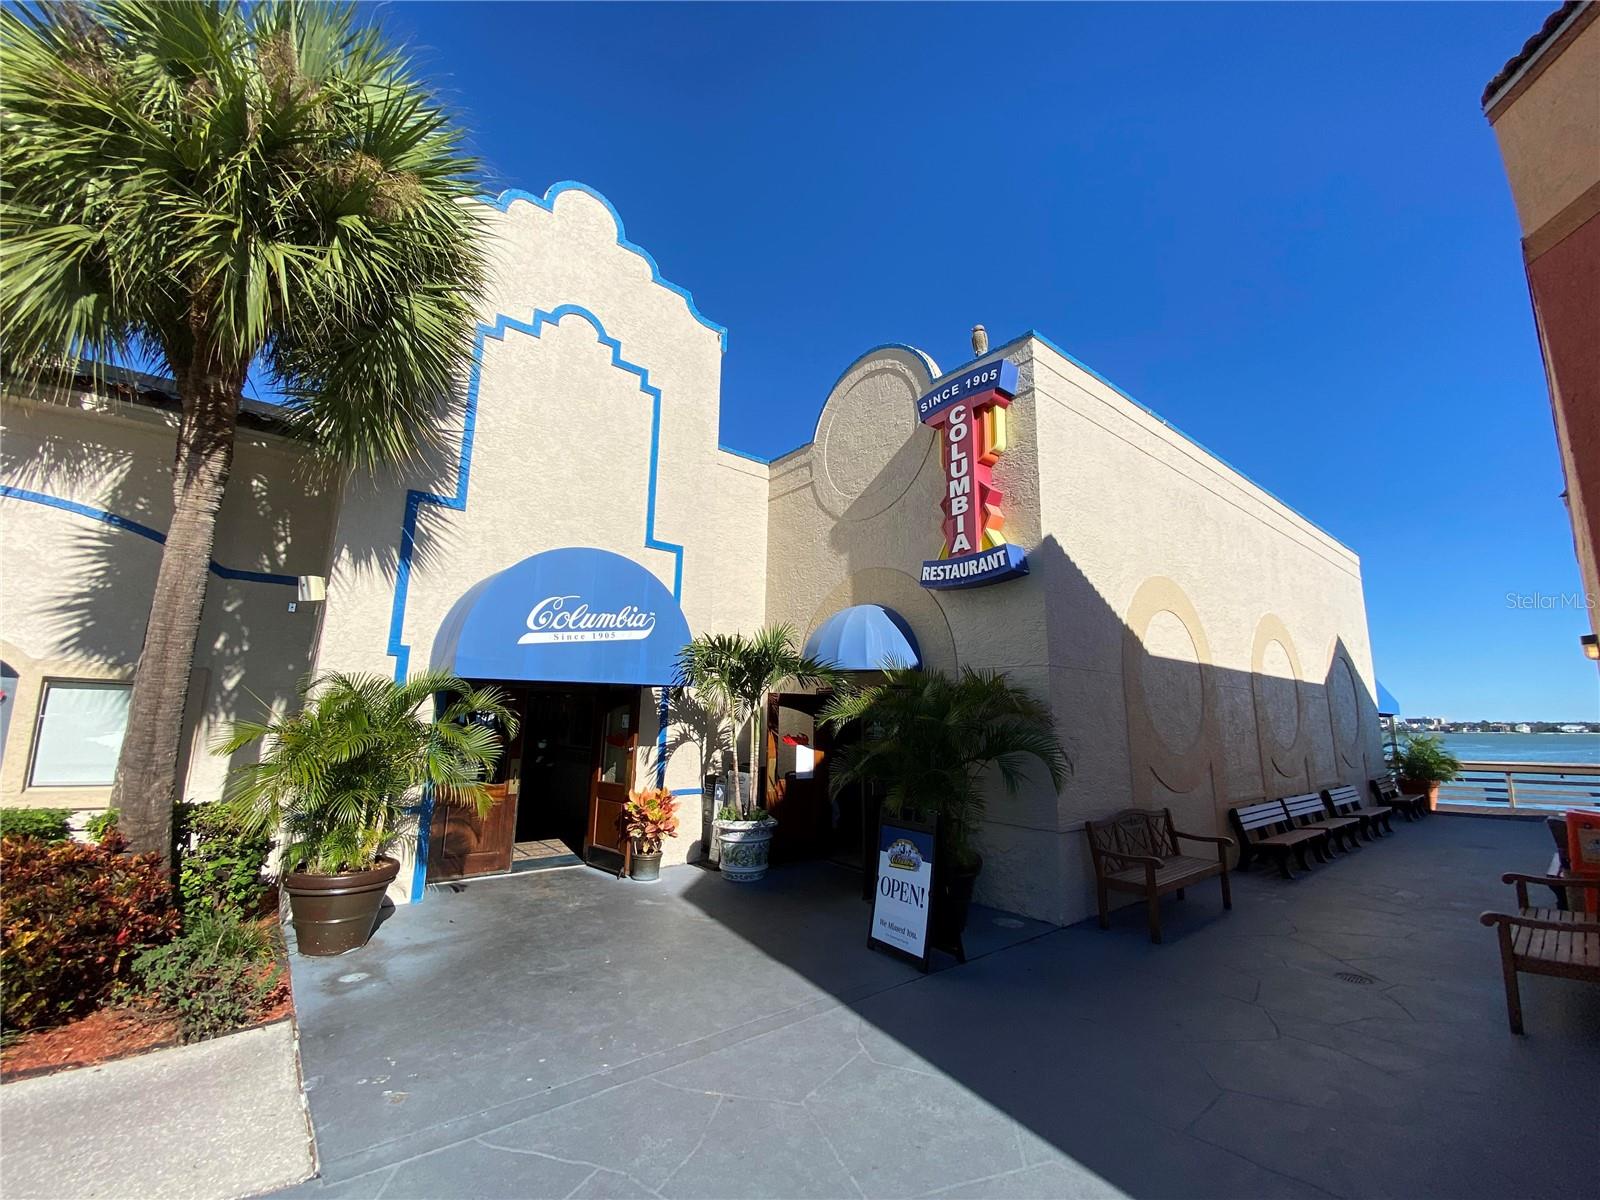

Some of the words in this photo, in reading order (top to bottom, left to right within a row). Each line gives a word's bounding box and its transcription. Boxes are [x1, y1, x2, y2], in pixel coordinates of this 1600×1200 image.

[920, 384, 960, 413] SINCE
[965, 369, 998, 389] 1905
[949, 405, 971, 554] COLUMBIA
[922, 550, 1006, 581] RESTAURANT
[526, 596, 653, 630] Columbia
[553, 633, 586, 641] Since
[880, 875, 925, 909] OPEN!
